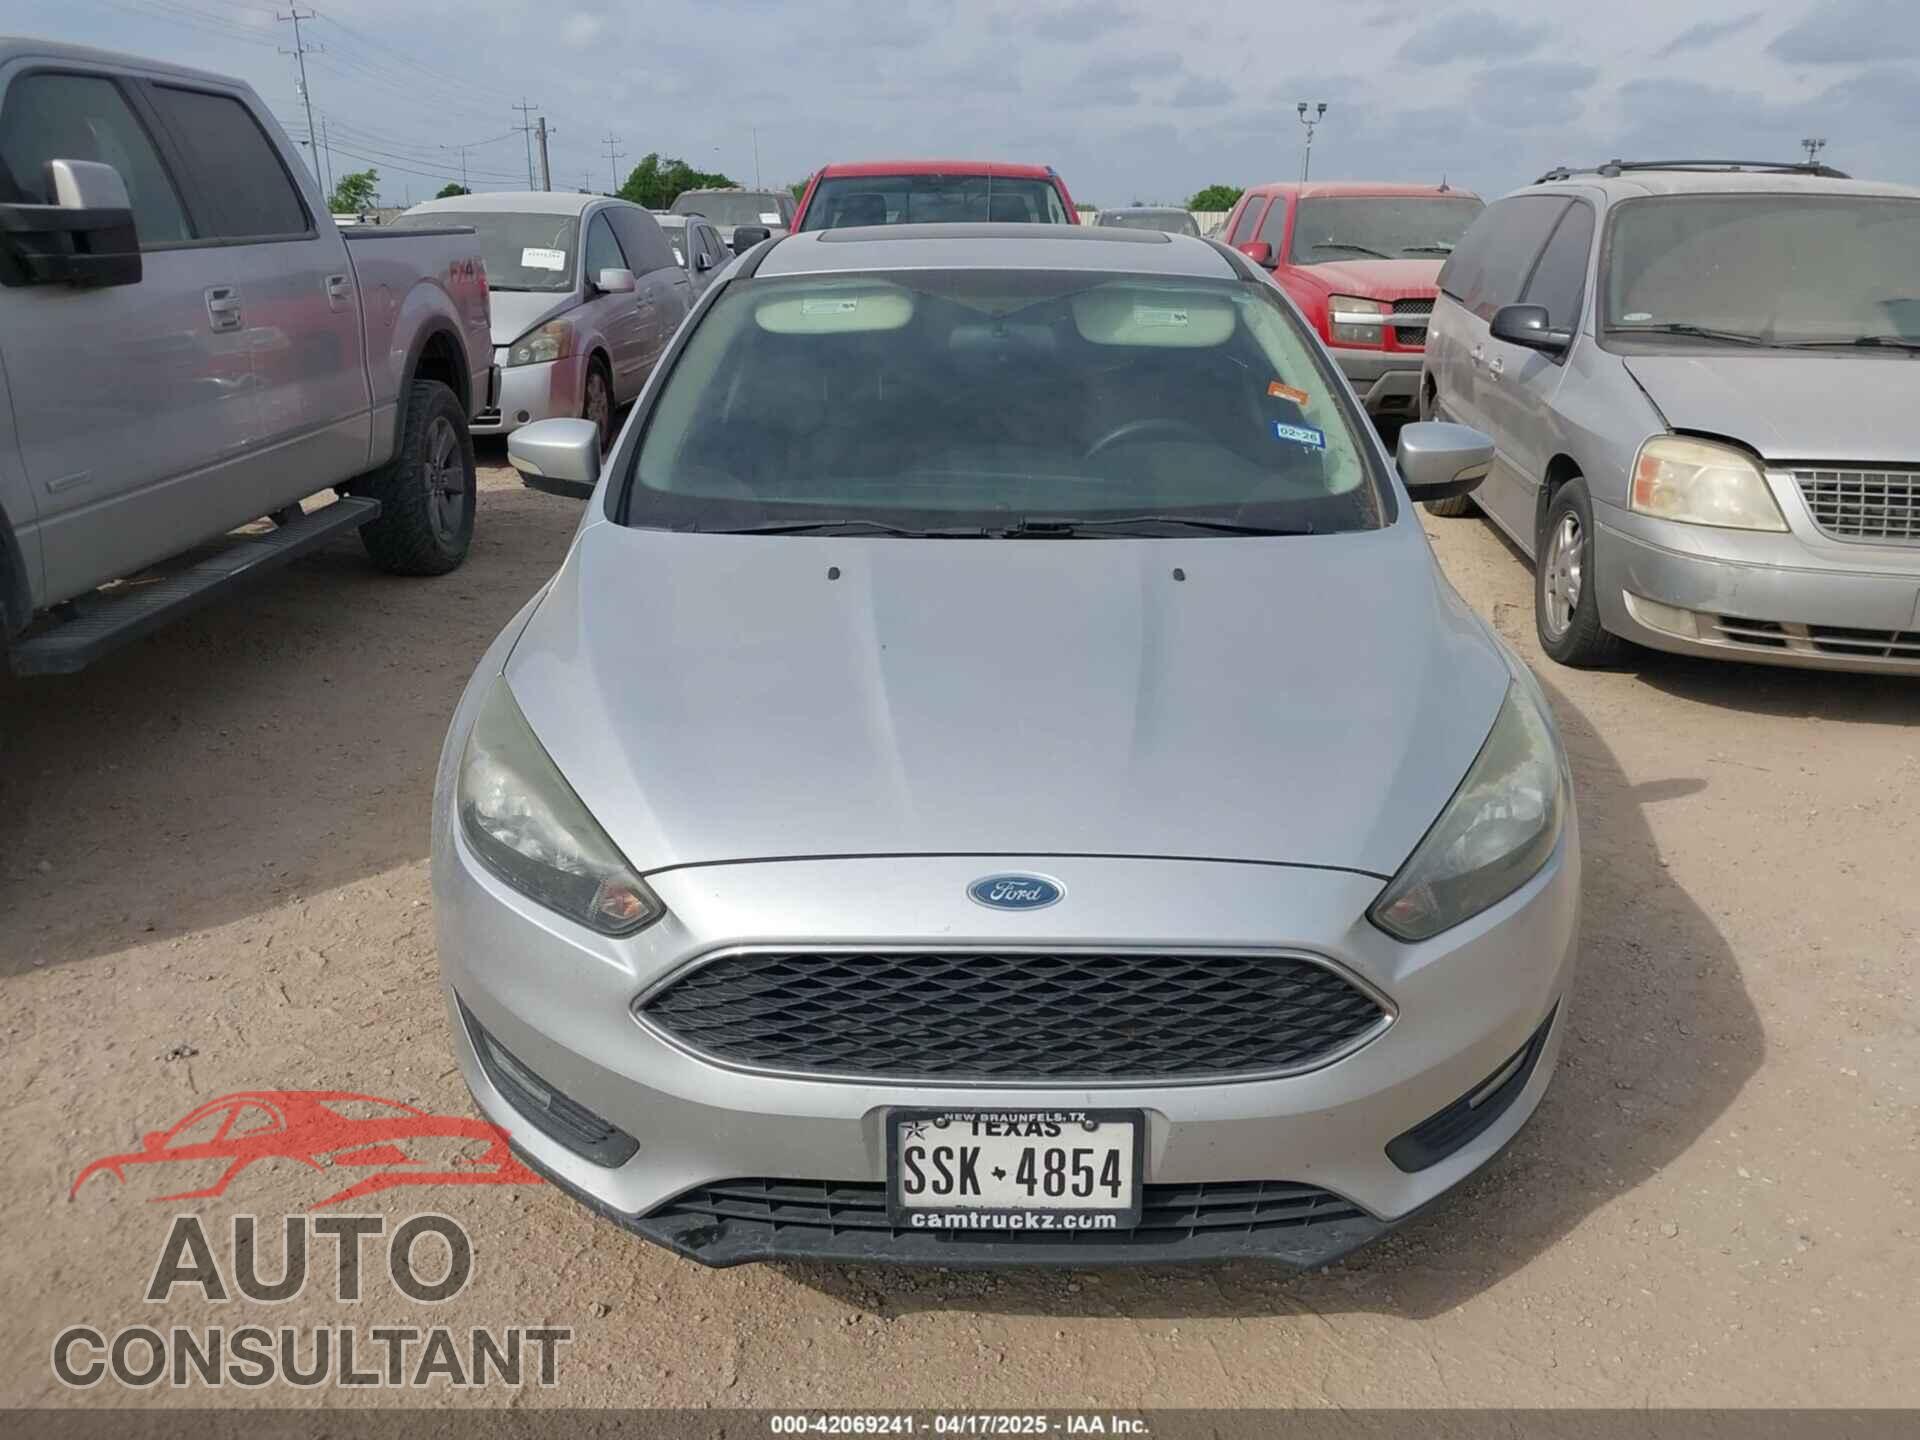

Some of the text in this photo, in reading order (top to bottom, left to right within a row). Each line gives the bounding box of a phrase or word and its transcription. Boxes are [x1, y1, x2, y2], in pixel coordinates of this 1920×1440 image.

[990, 880, 1042, 901] Ford
[944, 1113, 976, 1122] NEW
[1069, 1112, 1086, 1122] TX
[969, 1120, 1062, 1138] TEXAS
[903, 1146, 1122, 1198] SSK 4854
[911, 1211, 1116, 1229] camtruckz.com
